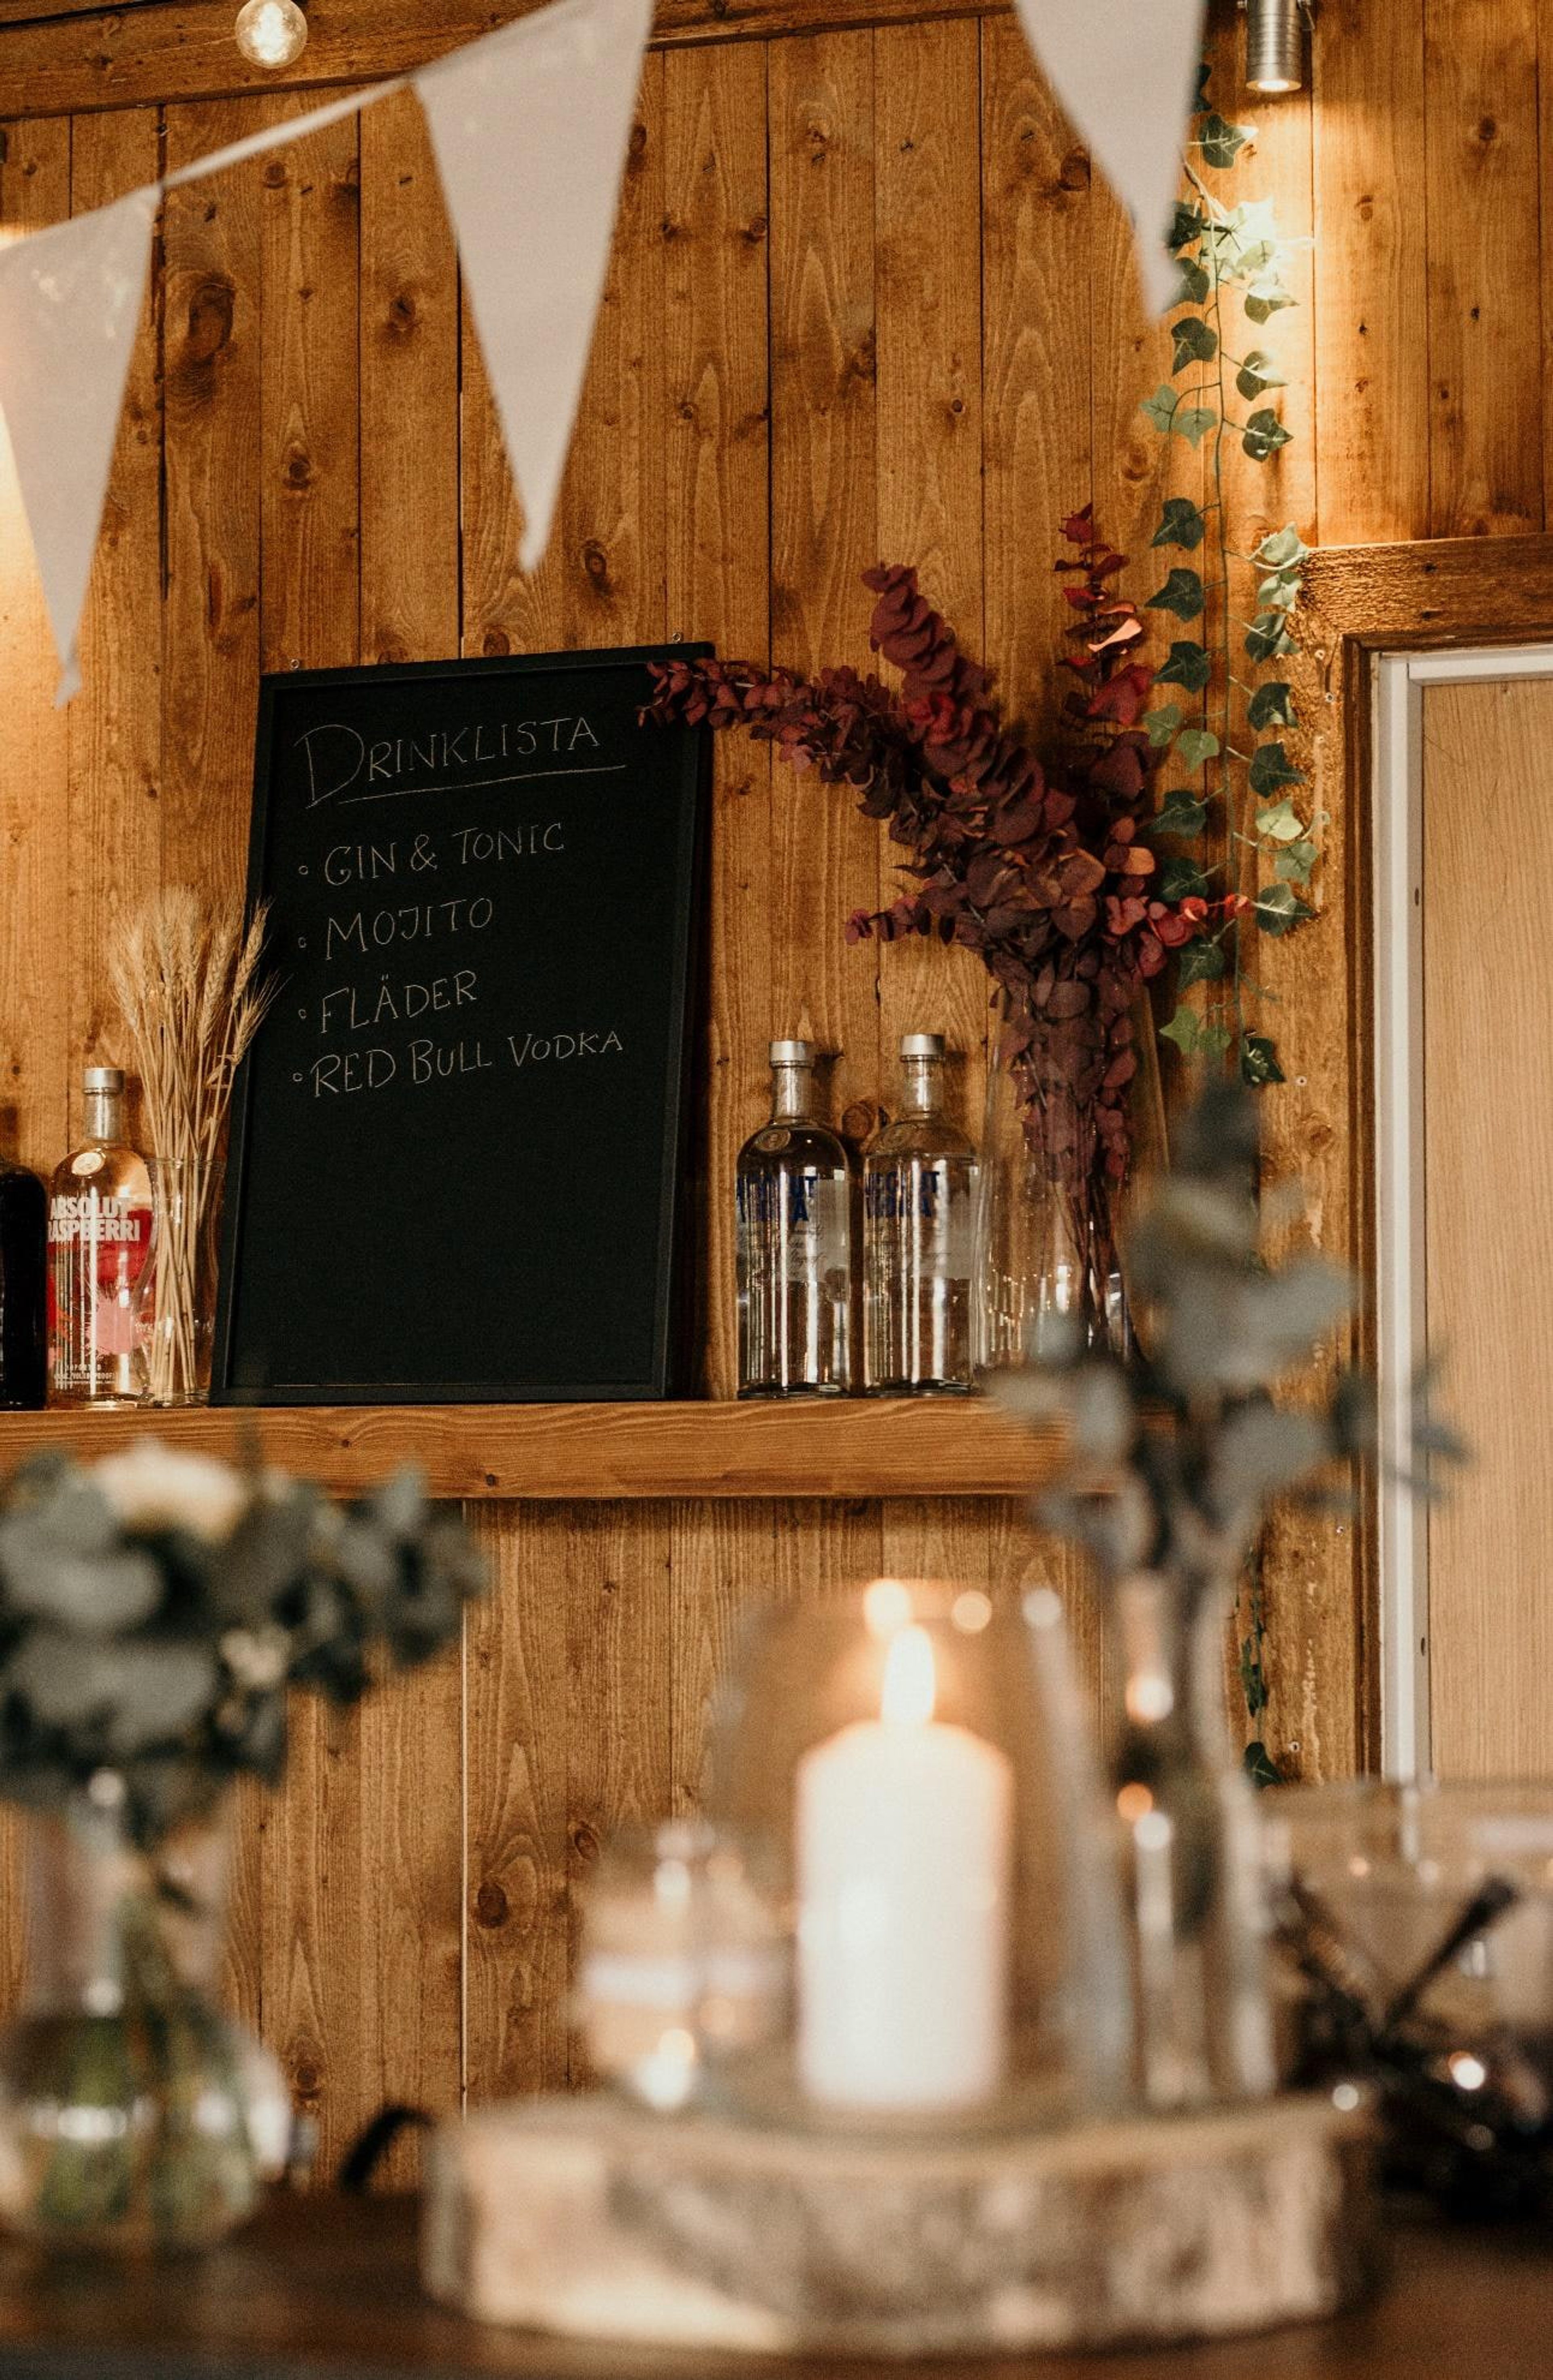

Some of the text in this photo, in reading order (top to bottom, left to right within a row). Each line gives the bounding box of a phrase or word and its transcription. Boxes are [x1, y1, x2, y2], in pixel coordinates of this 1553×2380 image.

[294, 717, 600, 809] DRINKLISTA
[325, 822, 565, 886] GIN & TONIC
[326, 898, 493, 960] MOJITO
[321, 970, 477, 1034] FLÄDER
[310, 1031, 623, 1098] RED BULL VODKA
[50, 1196, 134, 1219] ABSOLUT
